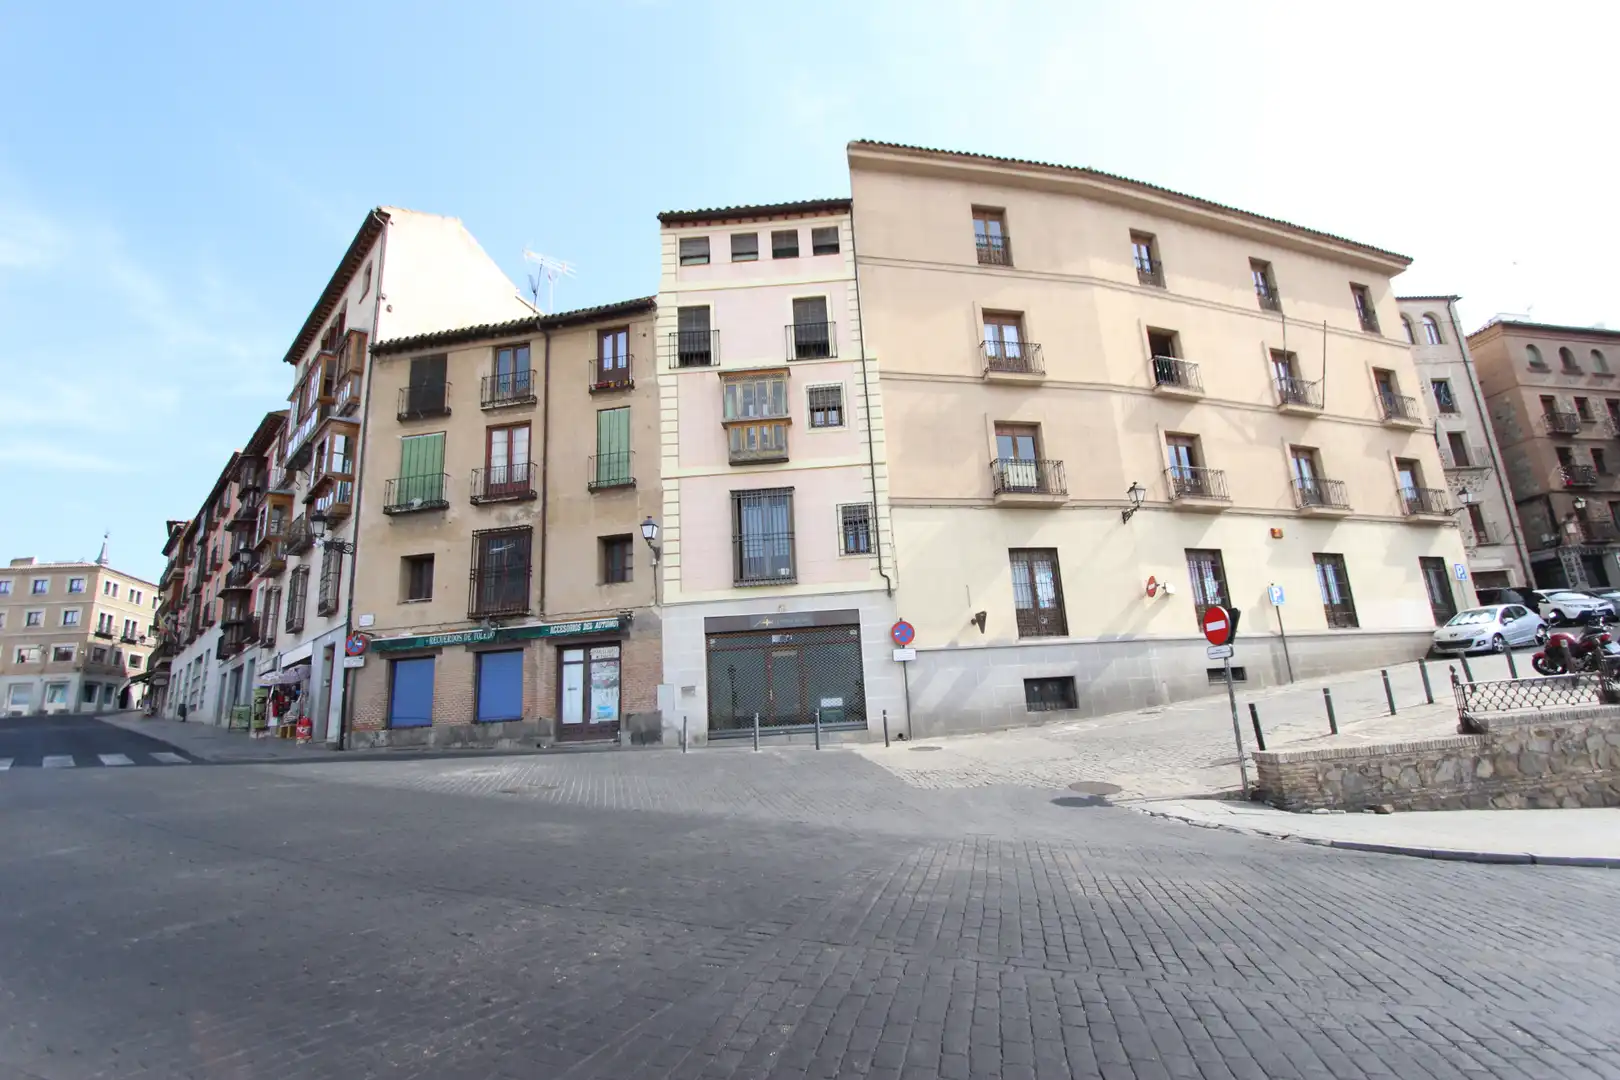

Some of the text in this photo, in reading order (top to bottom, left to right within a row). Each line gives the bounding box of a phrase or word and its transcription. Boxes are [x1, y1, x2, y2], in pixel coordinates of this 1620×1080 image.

[549, 623, 582, 635] ACCESORIOS
[582, 622, 593, 631] DEL
[429, 631, 496, 645] RECUERDOS DE TOLEDO
